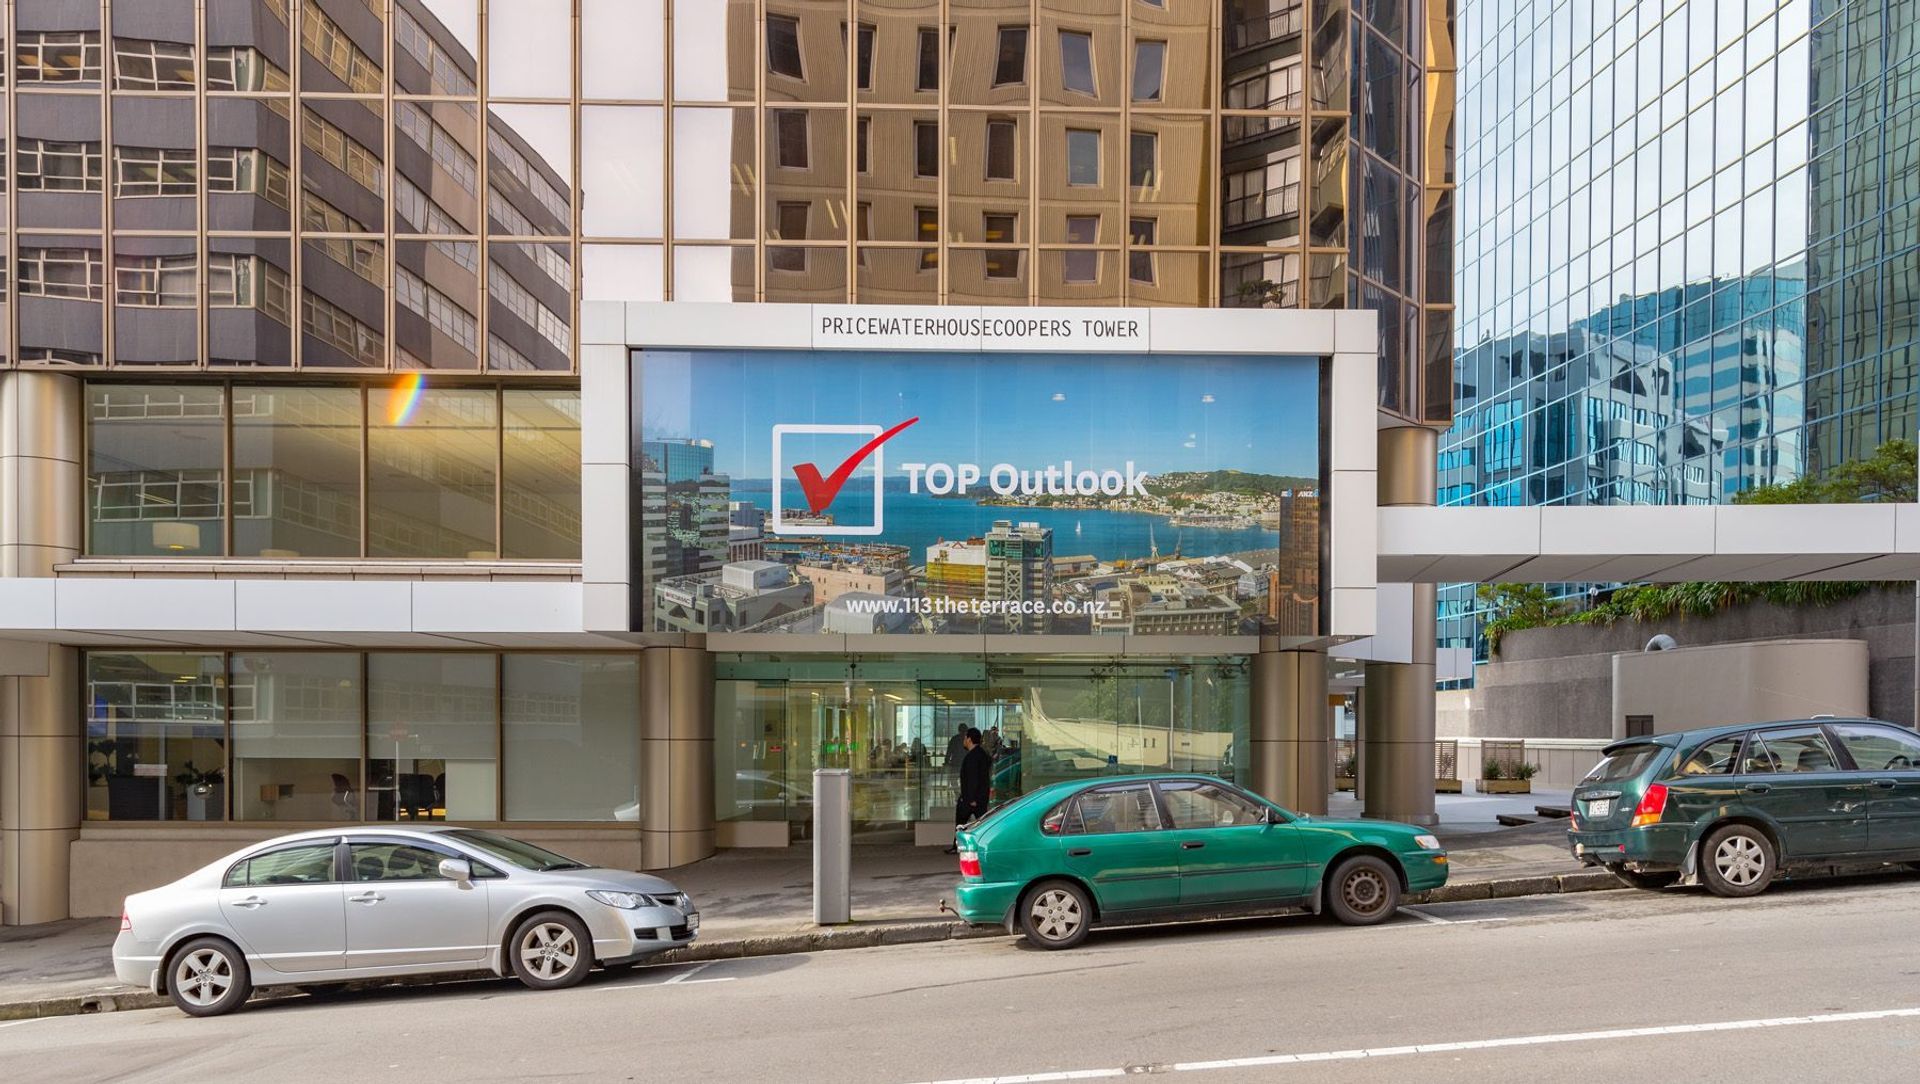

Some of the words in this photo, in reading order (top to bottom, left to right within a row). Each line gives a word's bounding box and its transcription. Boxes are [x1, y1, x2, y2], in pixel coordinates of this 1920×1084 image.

[822, 317, 1072, 337] PRICEWATERHOUSECOOPERS
[1082, 319, 1138, 338] TOWER
[902, 463, 981, 495] TOP
[989, 460, 1149, 496] Outlook
[846, 597, 1106, 614] www.113theterrace.co.nz
